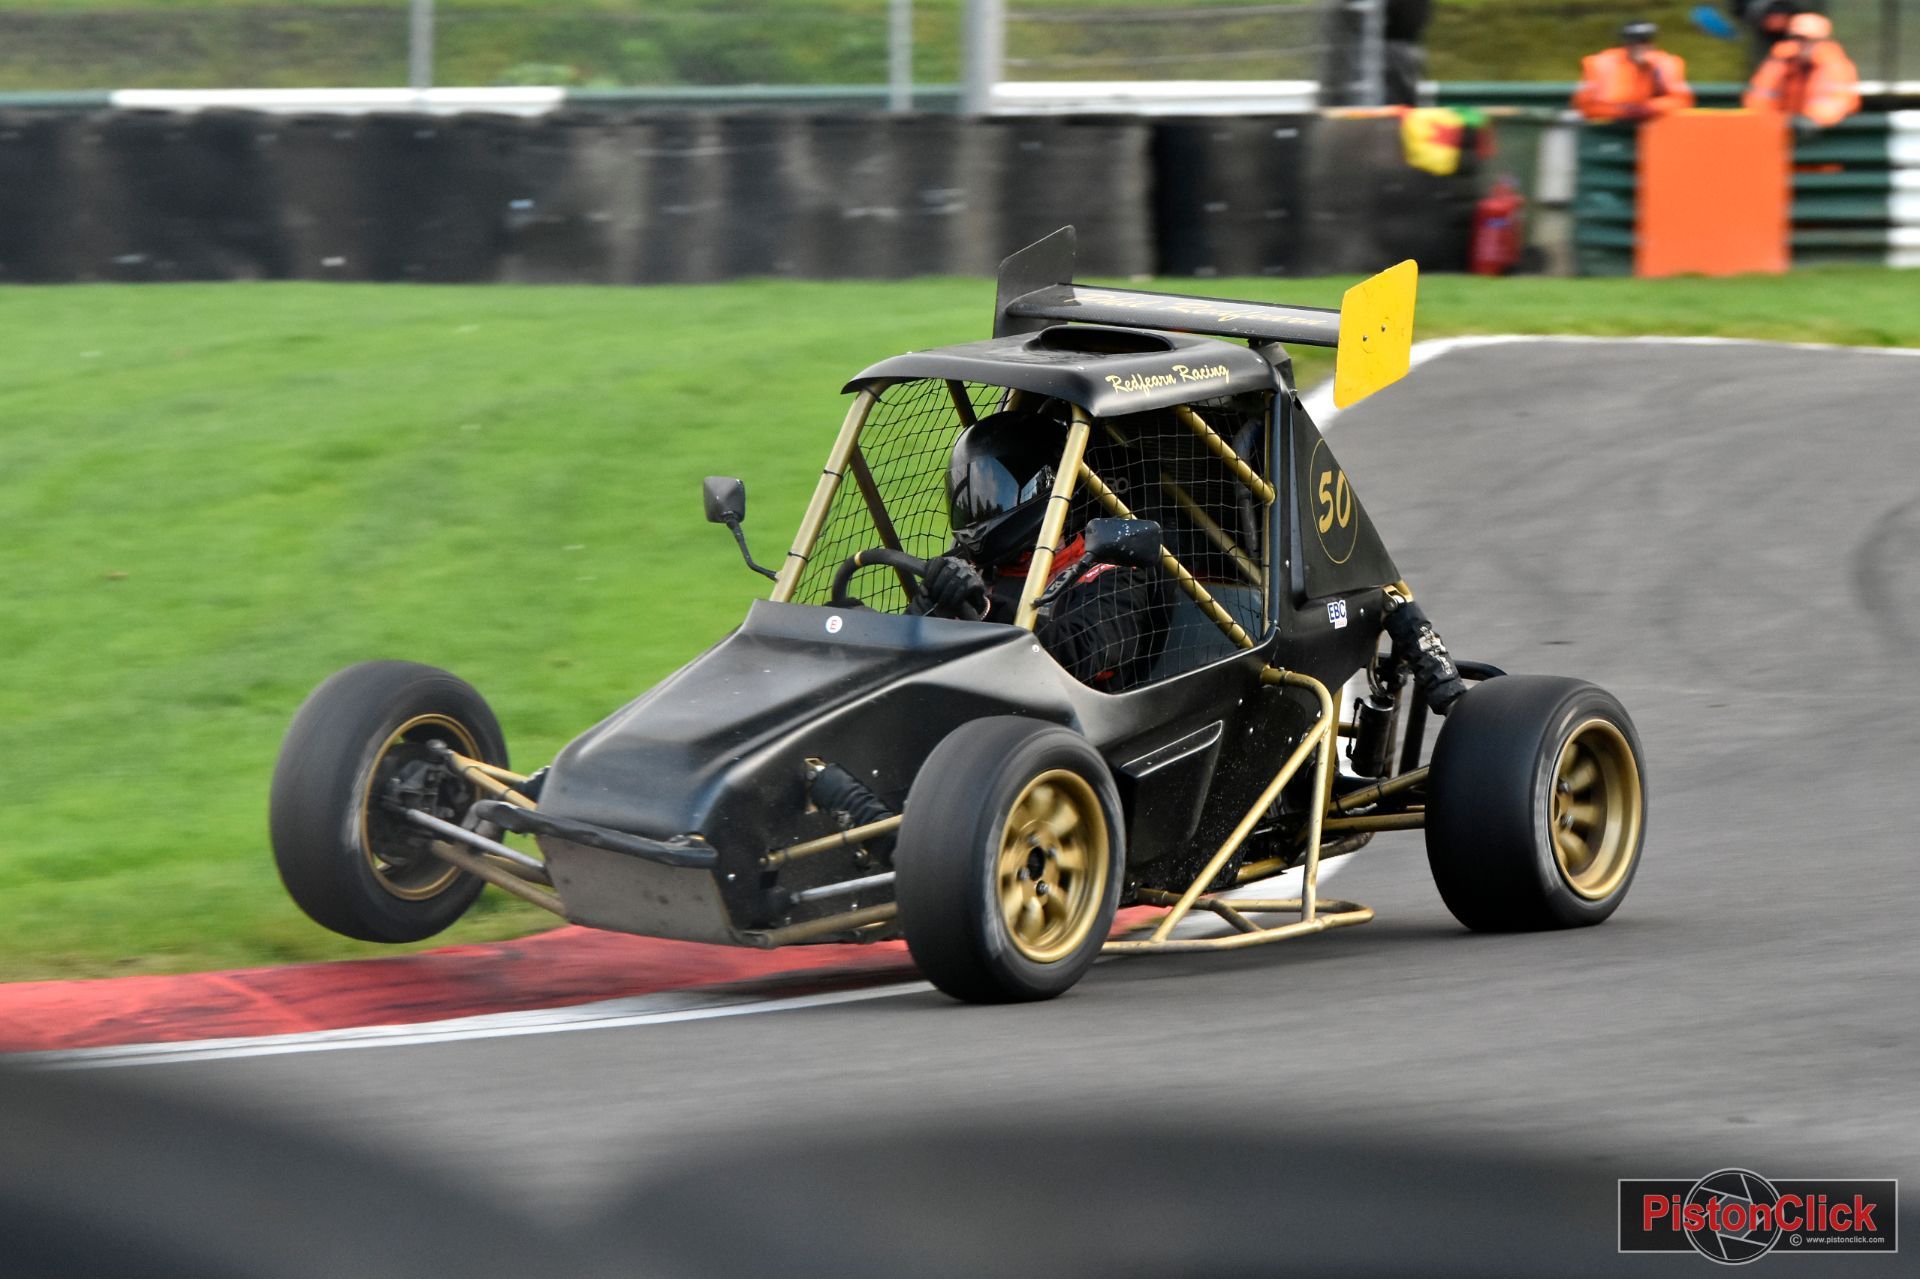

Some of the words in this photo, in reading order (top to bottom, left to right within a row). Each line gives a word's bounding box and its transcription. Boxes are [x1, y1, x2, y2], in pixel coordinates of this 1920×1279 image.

[1105, 373, 1177, 397] Redfearn
[1171, 364, 1230, 384] Racing
[1318, 469, 1351, 534] 50
[1327, 601, 1346, 621] EBC
